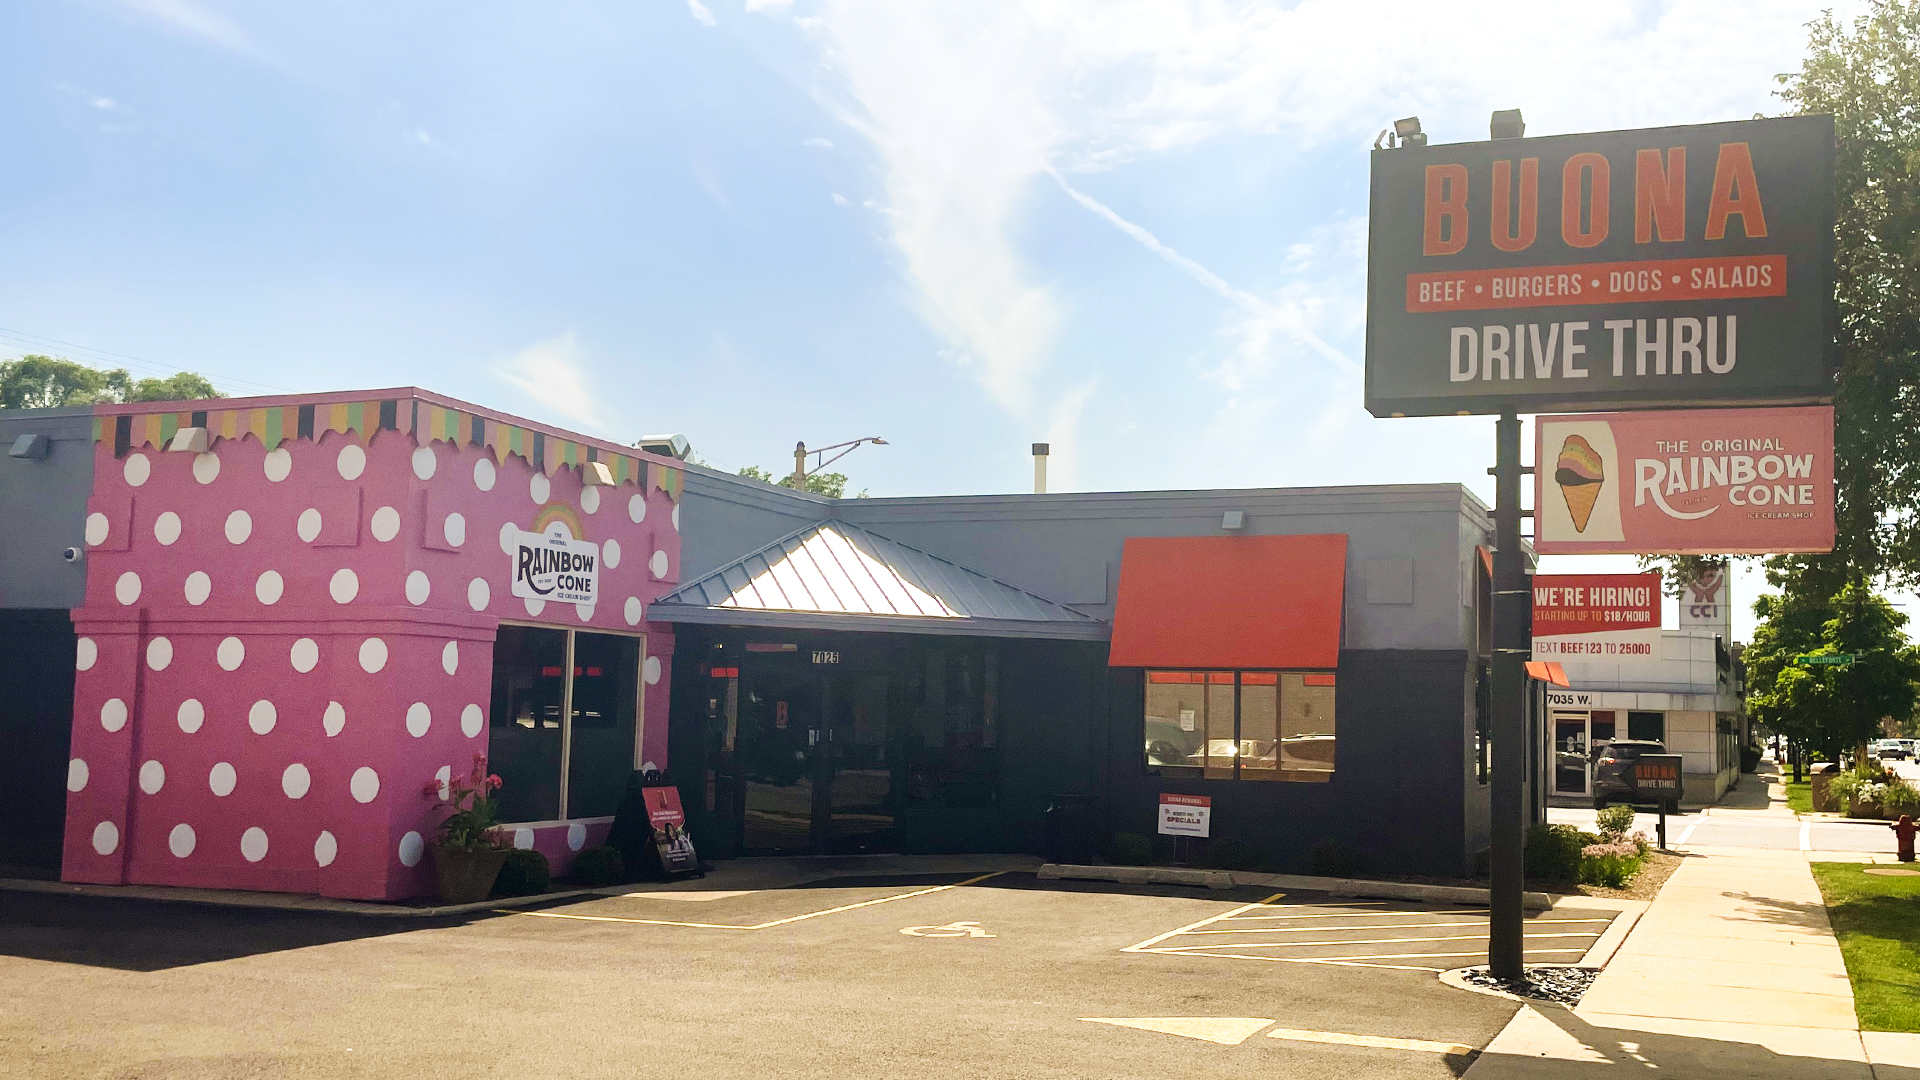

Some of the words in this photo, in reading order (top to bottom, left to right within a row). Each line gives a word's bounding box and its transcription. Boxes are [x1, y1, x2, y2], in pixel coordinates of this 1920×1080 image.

[1422, 141, 1769, 256] BUONA
[1418, 278, 1466, 303] BEEF
[1491, 273, 1583, 299] BURGERS
[1609, 269, 1663, 294] DOGS
[1690, 264, 1773, 289] SALADS
[1449, 321, 1589, 382] DRIVE
[1604, 314, 1737, 377] THRU
[1656, 440, 1689, 453] THE
[1701, 437, 1784, 452] ORIGINAL
[1634, 454, 1814, 520] RAINBOW
[1728, 484, 1815, 506] CONE
[1747, 511, 1760, 519] ICE
[1762, 511, 1790, 519] CREAM
[1791, 511, 1815, 519] SHOP
[517, 545, 594, 595] RAINBOW
[557, 574, 591, 593] CONE
[1534, 587, 1585, 607] WE'RE
[1589, 587, 1651, 607] HIRING!
[1534, 610, 1575, 621] STARTING
[1577, 610, 1589, 621] UP
[1591, 610, 1602, 621] TO
[1604, 610, 1651, 622] $18/HOUR
[1690, 605, 1718, 618] CCI
[1535, 641, 1558, 654] TEXT
[1560, 642, 1602, 654] BEEF123
[1605, 642, 1617, 654] TO
[1619, 643, 1651, 655] 25000
[813, 652, 838, 663] 7025
[1547, 694, 1574, 704] 7035
[1577, 695, 1592, 704] W.
[1635, 765, 1677, 778] BUONA
[1637, 779, 1657, 788] DRIVE
[1658, 779, 1676, 789] THRU
